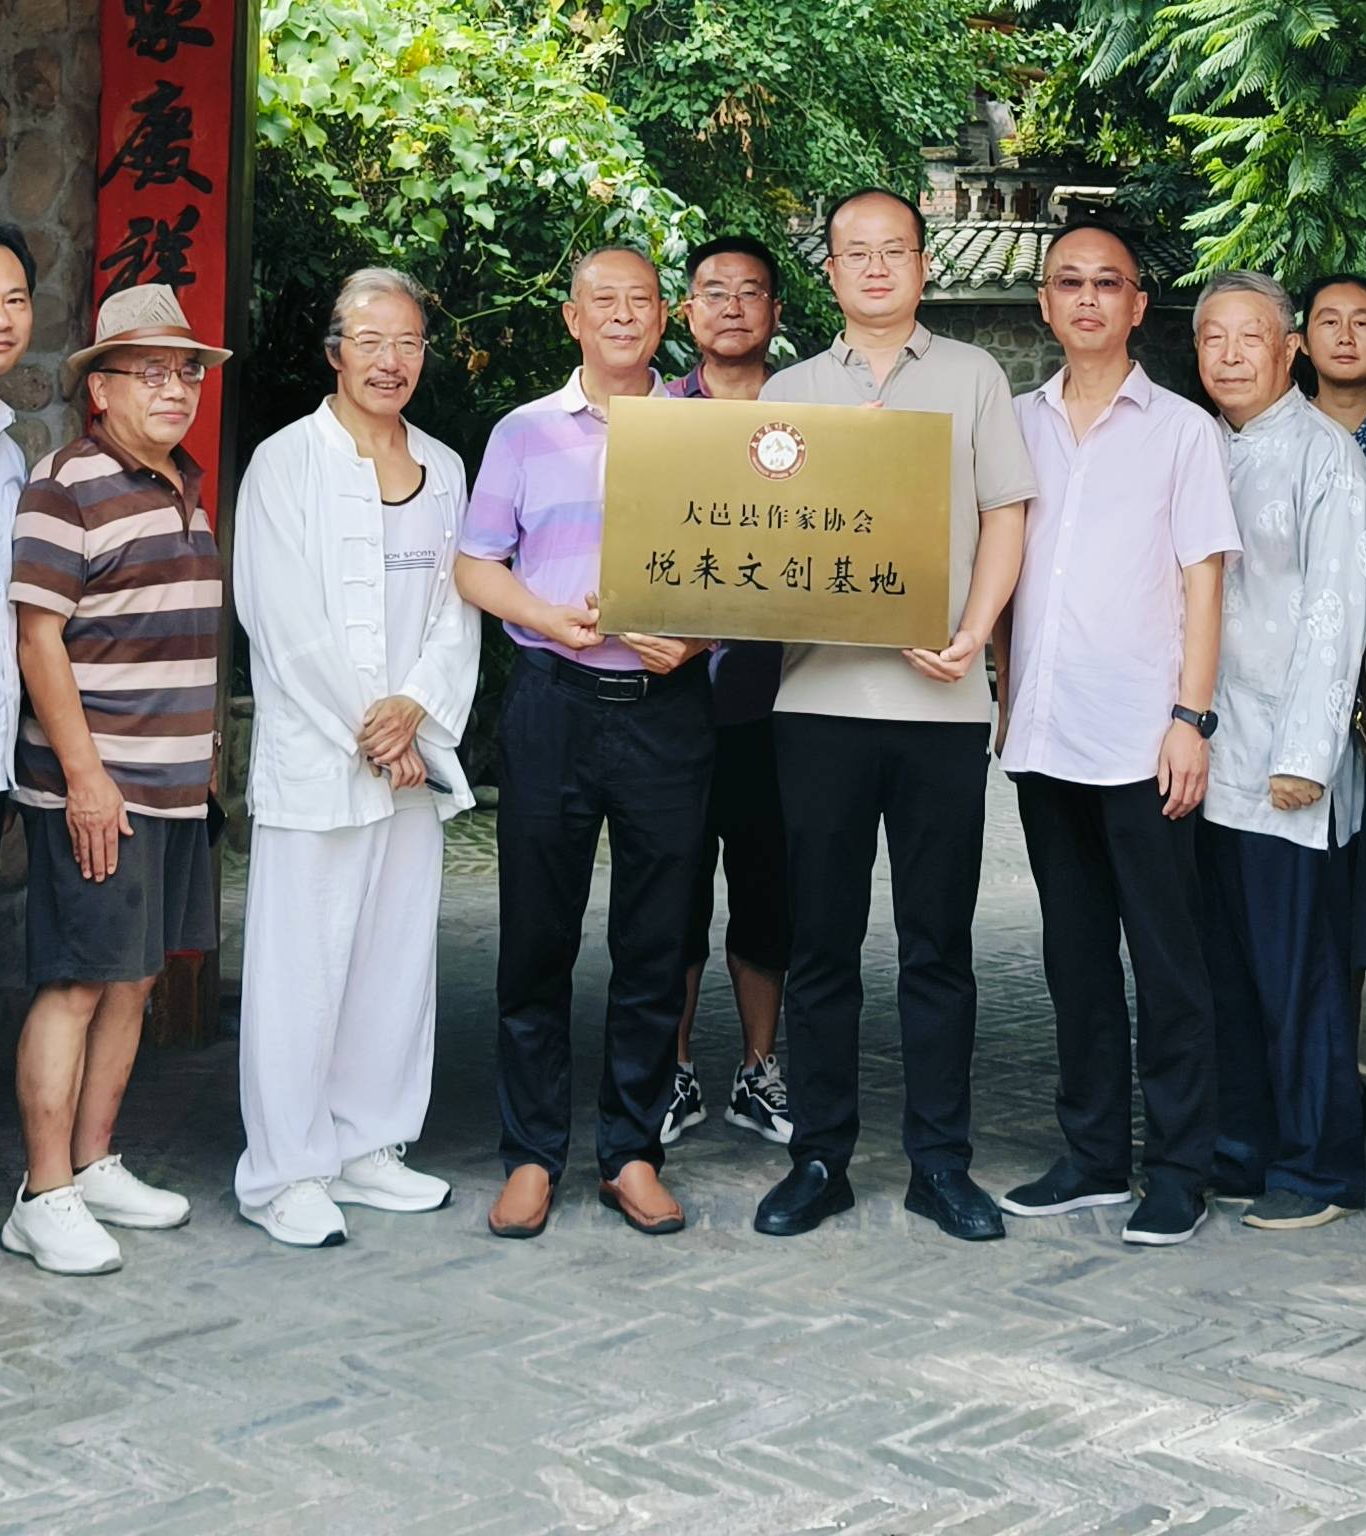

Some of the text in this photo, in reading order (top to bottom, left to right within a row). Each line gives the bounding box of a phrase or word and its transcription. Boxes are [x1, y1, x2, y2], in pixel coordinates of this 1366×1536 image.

[681, 500, 875, 535] 大邑县作家协会
[403, 550, 436, 558] SPORTS
[645, 547, 906, 596] 悦来文创基地
